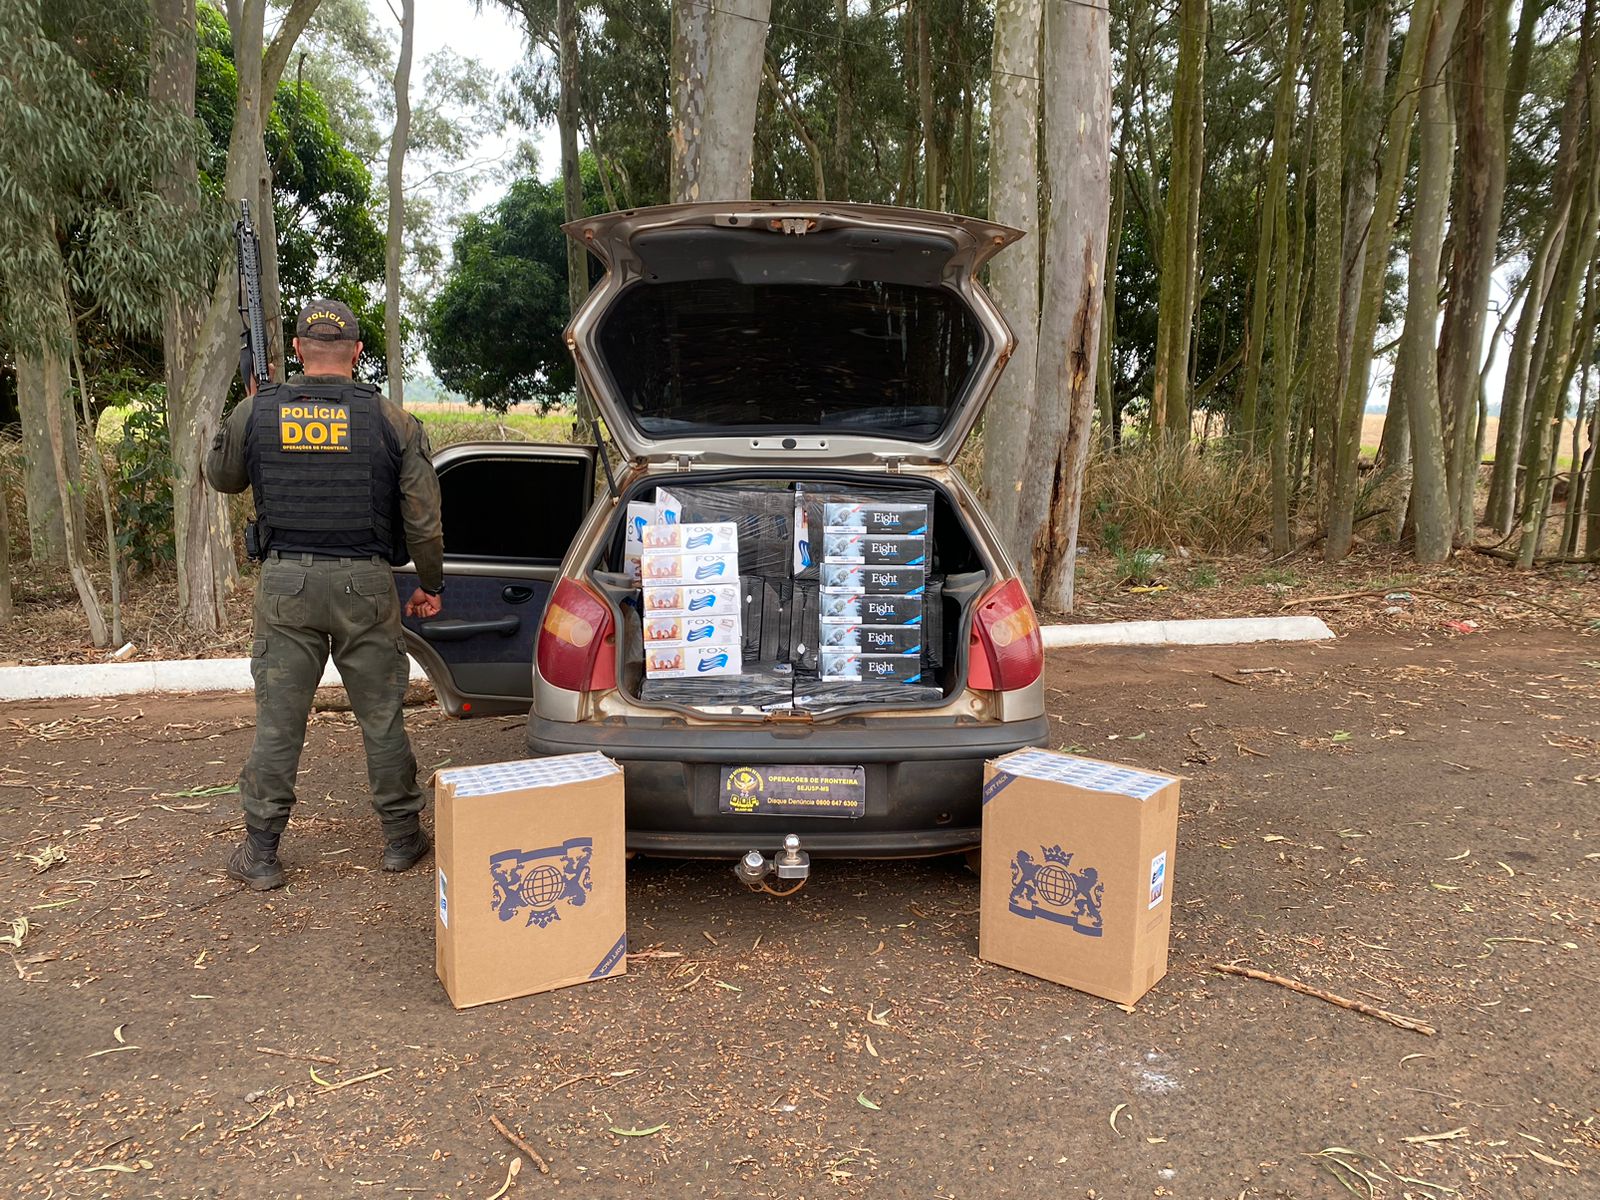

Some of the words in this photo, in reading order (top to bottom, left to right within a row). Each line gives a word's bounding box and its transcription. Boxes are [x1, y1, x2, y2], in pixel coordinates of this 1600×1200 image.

[306, 311, 346, 328] POLÍCIA
[281, 405, 347, 420] POLÍCIA
[281, 421, 348, 445] DOF
[873, 512, 900, 526] Eight
[871, 542, 898, 556] Eight
[871, 573, 898, 586] Eight
[868, 603, 895, 616] Eight
[867, 632, 894, 645] Eight
[868, 661, 894, 675] Eight
[768, 776, 808, 784] OPERAÇÕES
[820, 777, 858, 785] FRONTEIRA
[767, 797, 787, 805] Disque
